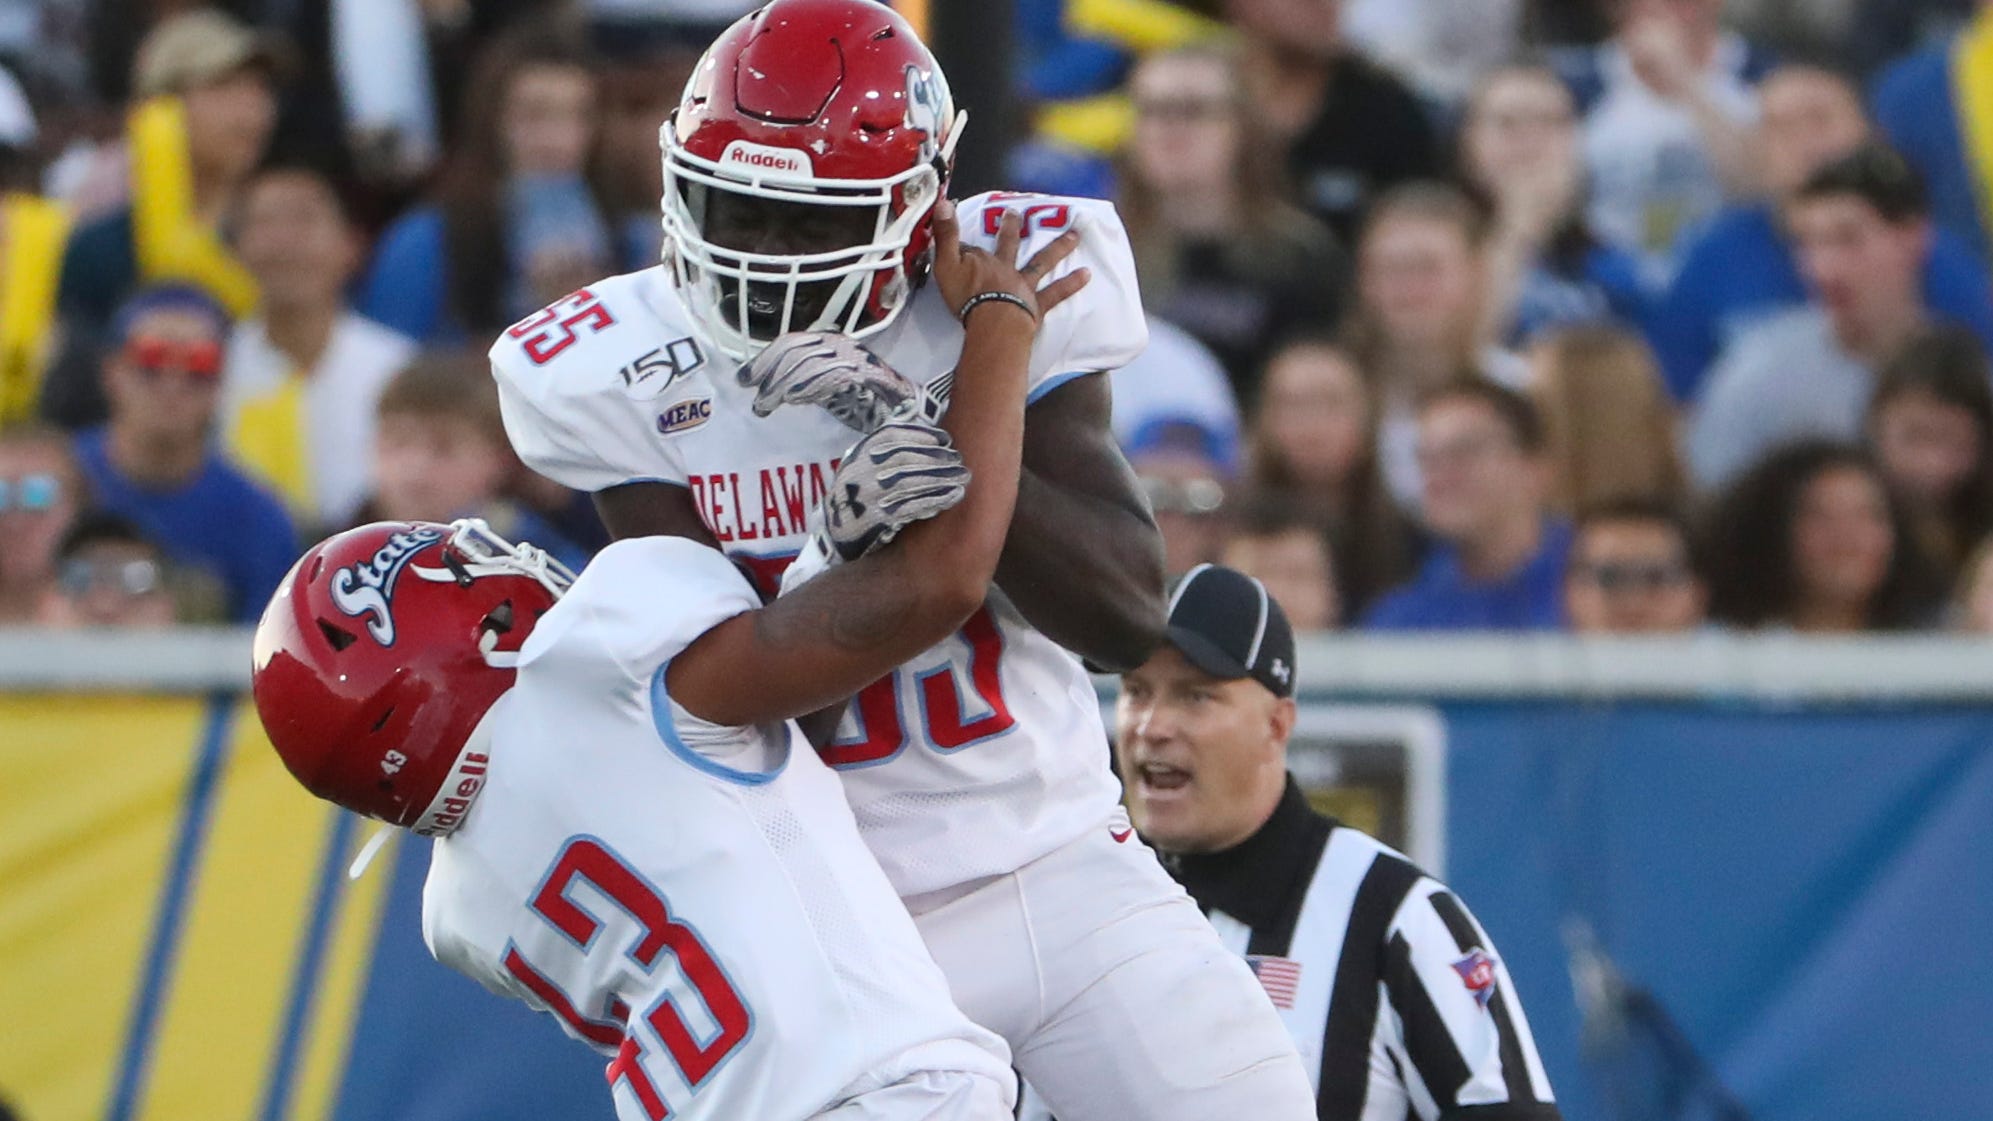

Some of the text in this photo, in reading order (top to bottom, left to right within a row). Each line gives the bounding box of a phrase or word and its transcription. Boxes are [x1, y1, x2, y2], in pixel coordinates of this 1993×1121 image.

[507, 288, 617, 366] 55
[619, 336, 706, 394] 150
[658, 399, 712, 429] MEAC
[688, 457, 842, 542] DELAWA
[330, 529, 442, 647] State
[381, 749, 407, 775] 43
[500, 833, 755, 1121] 43
